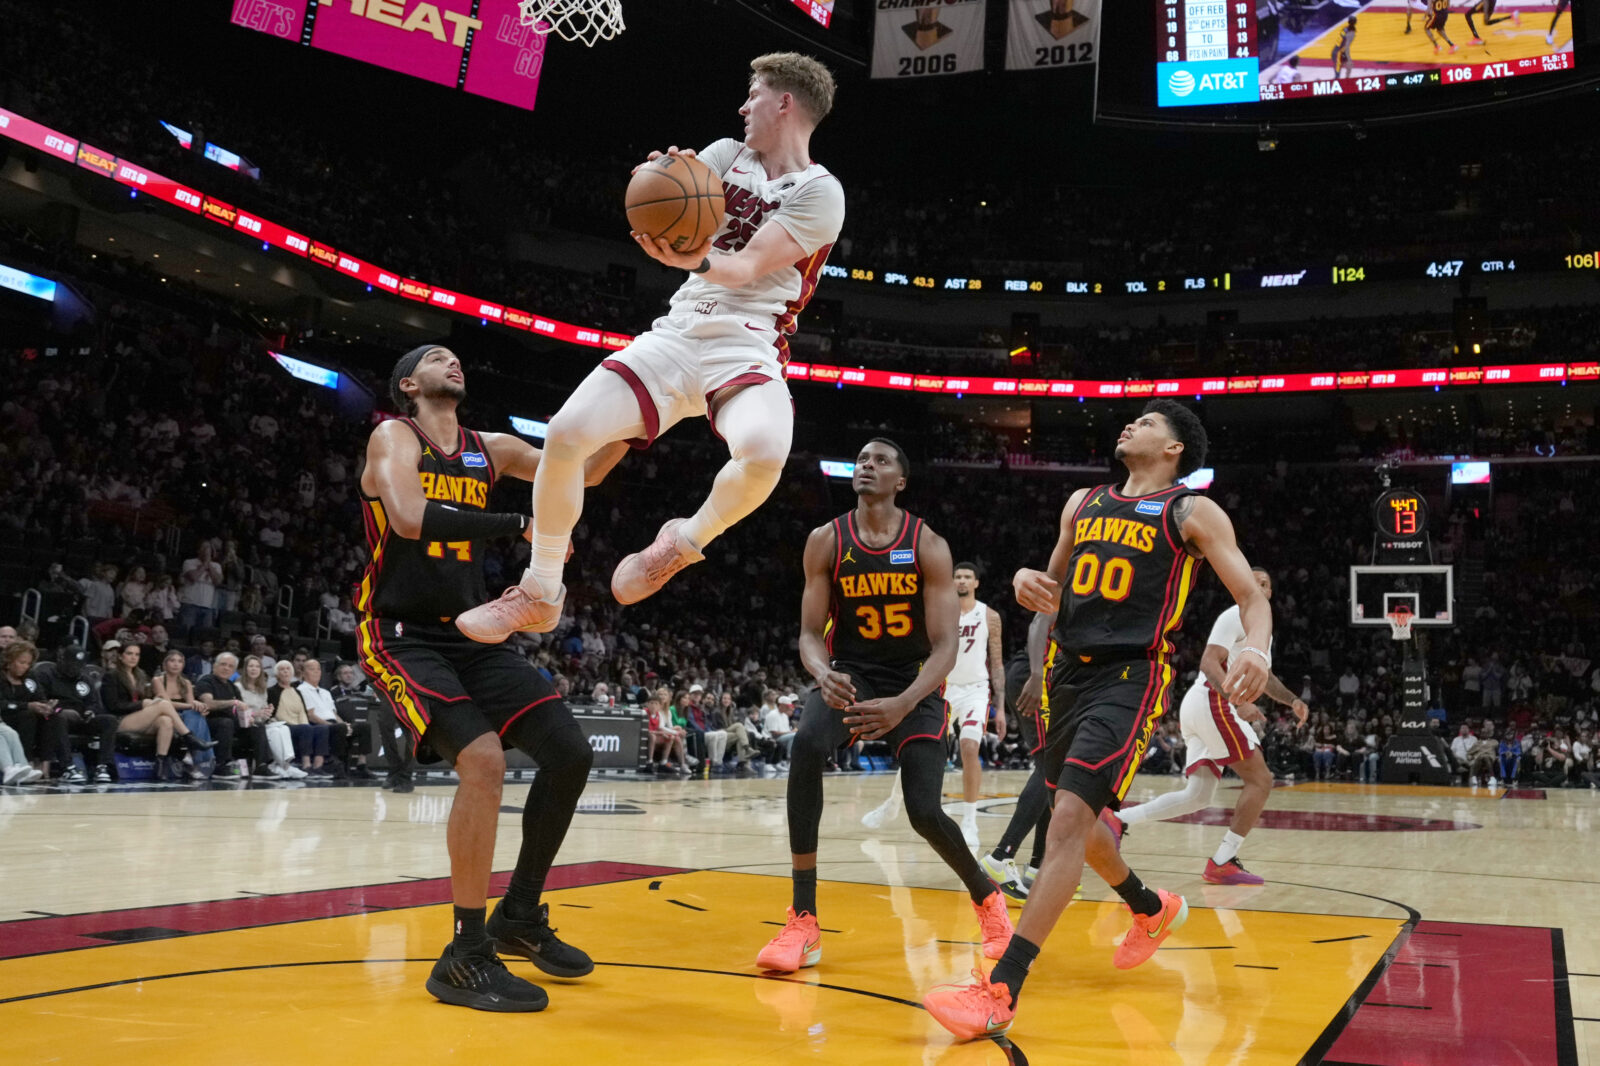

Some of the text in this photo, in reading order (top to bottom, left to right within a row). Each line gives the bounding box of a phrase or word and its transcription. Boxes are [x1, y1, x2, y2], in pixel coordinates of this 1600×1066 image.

[1167, 3, 1247, 18] 11 OFF REB 10
[1237, 17, 1246, 28] 11
[1202, 34, 1213, 43] TO
[1035, 42, 1093, 66] 2012
[1236, 46, 1249, 57] 44
[514, 48, 544, 78] GO
[898, 53, 957, 76] 2006
[1199, 72, 1248, 91] AT&T
[1313, 81, 1342, 95] MIA
[1356, 77, 1380, 91] 124
[1403, 74, 1424, 85] 4:47
[1447, 67, 1472, 81] 106
[1483, 63, 1514, 79] ATL
[78, 149, 117, 171] HEAT
[203, 201, 236, 222] HEAT
[310, 245, 338, 263] HEAT
[822, 265, 848, 278] FG%
[885, 273, 908, 285] 3P%
[944, 278, 967, 289] AST
[1005, 280, 1028, 291] REB
[1029, 281, 1043, 291] 40
[1066, 282, 1088, 293] BLK
[1094, 283, 1102, 293] 2
[1126, 282, 1147, 292] TOL
[1158, 281, 1166, 291] 2
[1185, 278, 1205, 289] FLS
[1213, 278, 1218, 287] 1
[1260, 270, 1306, 287] HEAT
[1338, 268, 1365, 282] 124
[1426, 261, 1463, 278] 4:47
[1481, 261, 1503, 271] QTR
[1508, 260, 1515, 271] 4
[1565, 255, 1593, 269] 106
[400, 282, 431, 298] HEAT
[504, 312, 533, 326] HEAT
[810, 367, 841, 379] HEAT
[1450, 370, 1483, 380] HEAT
[1568, 366, 1600, 376] HEAT
[914, 378, 944, 388] HEAT
[1018, 382, 1050, 392] HEAT
[1228, 380, 1260, 389] HEAT
[1338, 375, 1370, 385] HEAT
[1125, 384, 1155, 393] HEAT
[420, 472, 488, 509] HAWKS
[1391, 499, 1417, 512] 4:47
[1396, 511, 1416, 533] 13
[1074, 517, 1158, 552] HAWKS
[840, 572, 918, 598] HAWKS
[1072, 552, 1134, 602] 00
[856, 603, 913, 640] 35
[964, 638, 976, 653] 7
